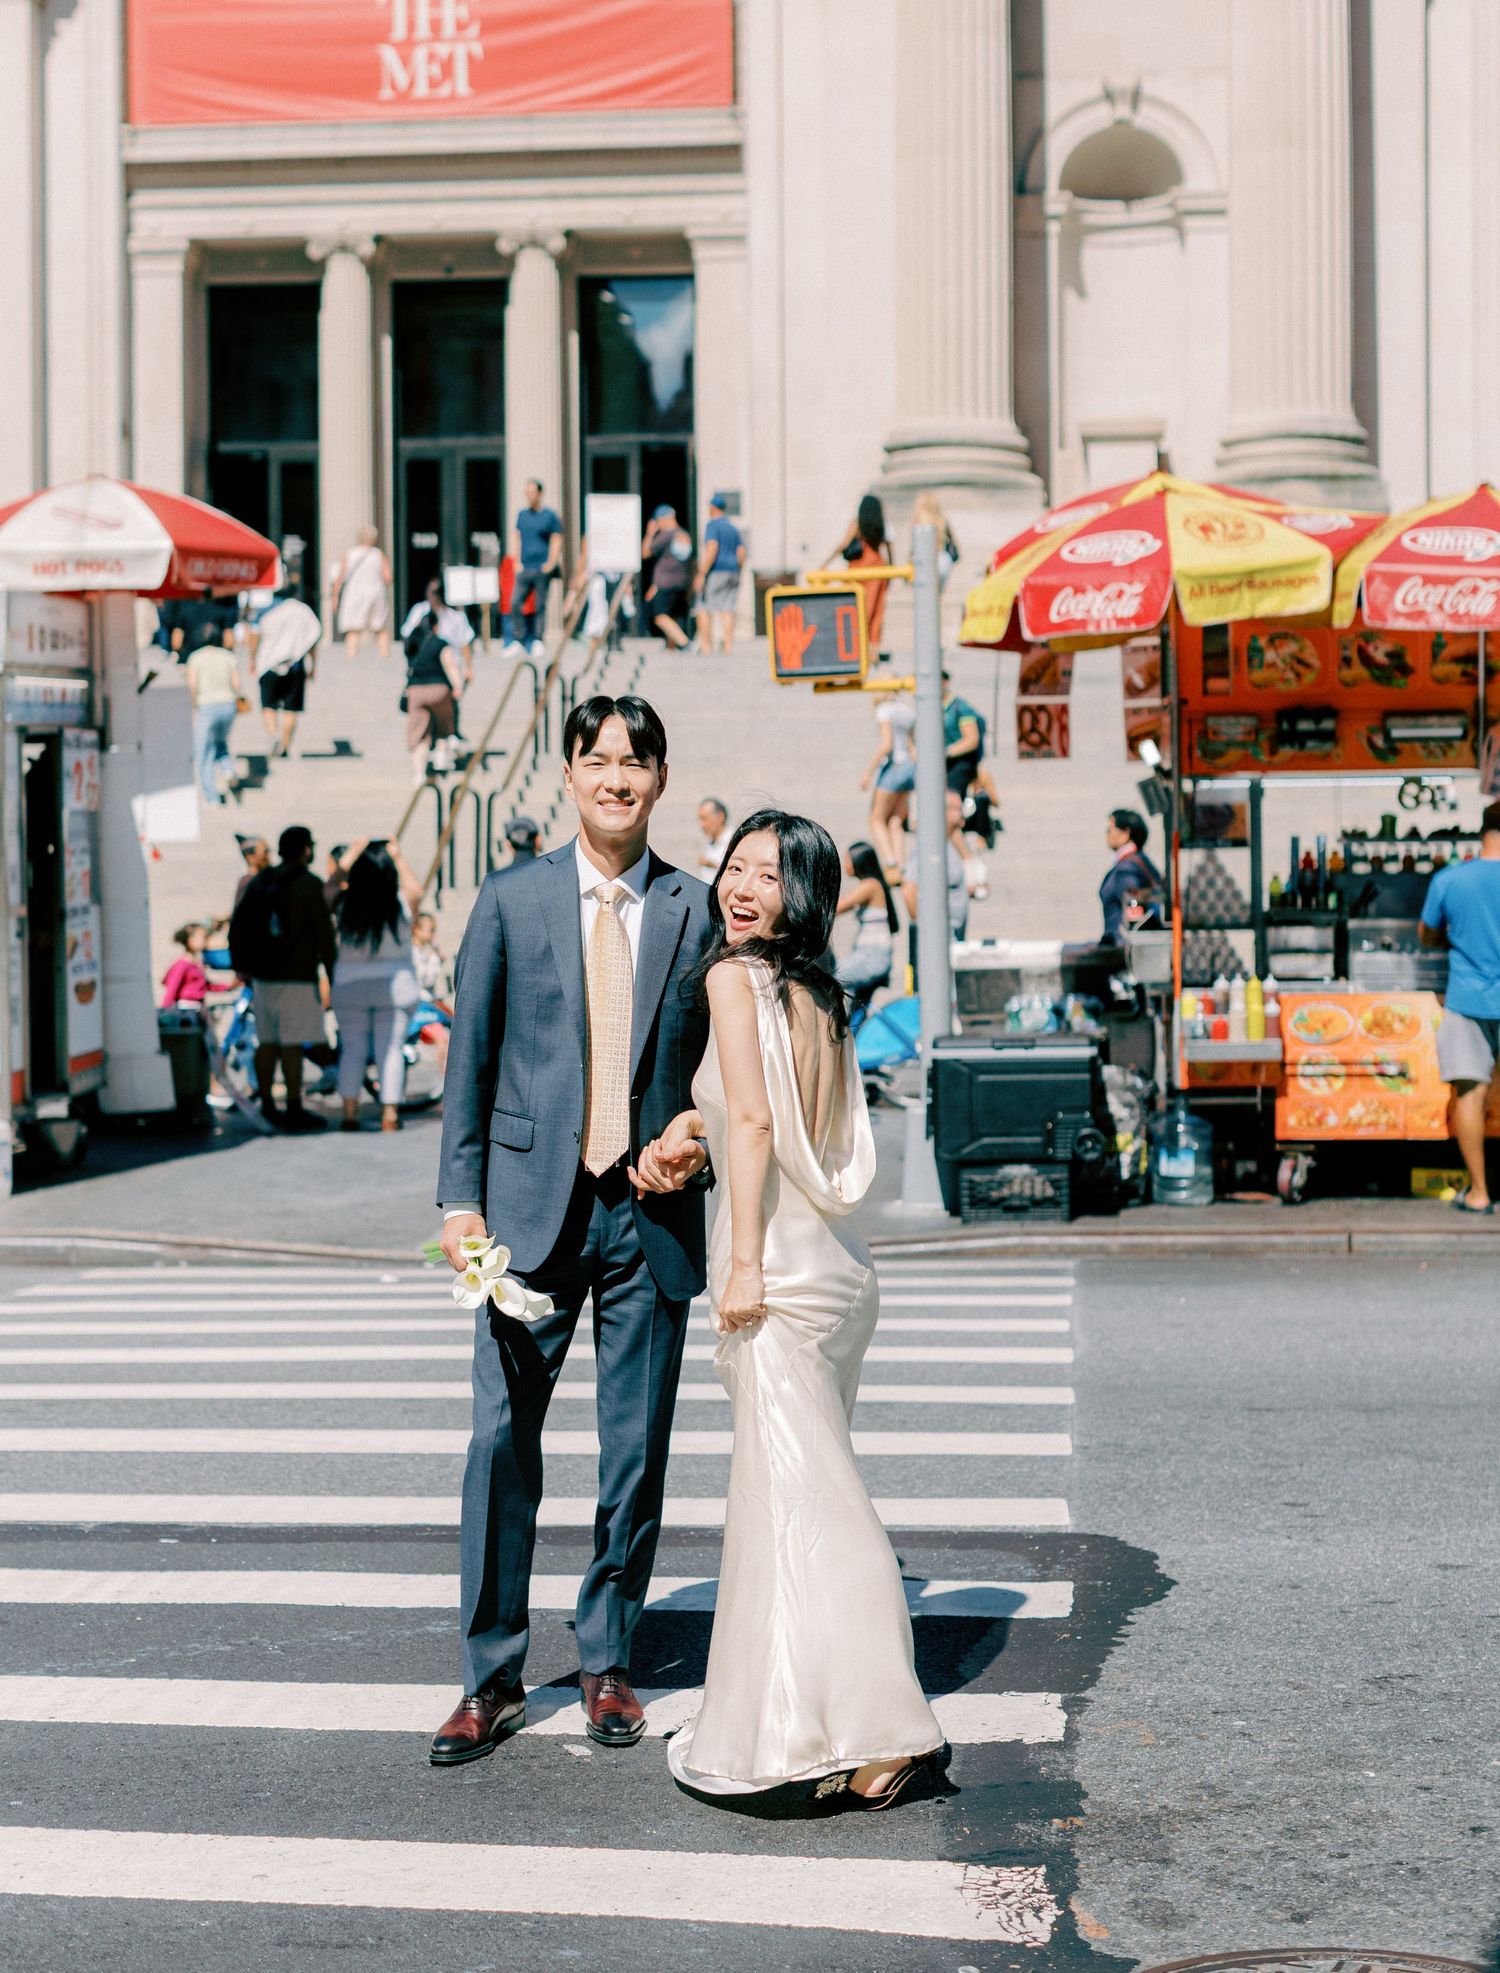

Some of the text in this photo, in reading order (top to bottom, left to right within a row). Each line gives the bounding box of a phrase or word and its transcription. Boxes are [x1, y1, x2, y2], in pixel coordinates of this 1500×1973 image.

[376, 0, 481, 42] THE
[377, 42, 484, 101] MET
[33, 558, 126, 576] HOT DOGS
[1189, 574, 1320, 600] All Beef Sausages
[836, 606, 859, 661] 0
